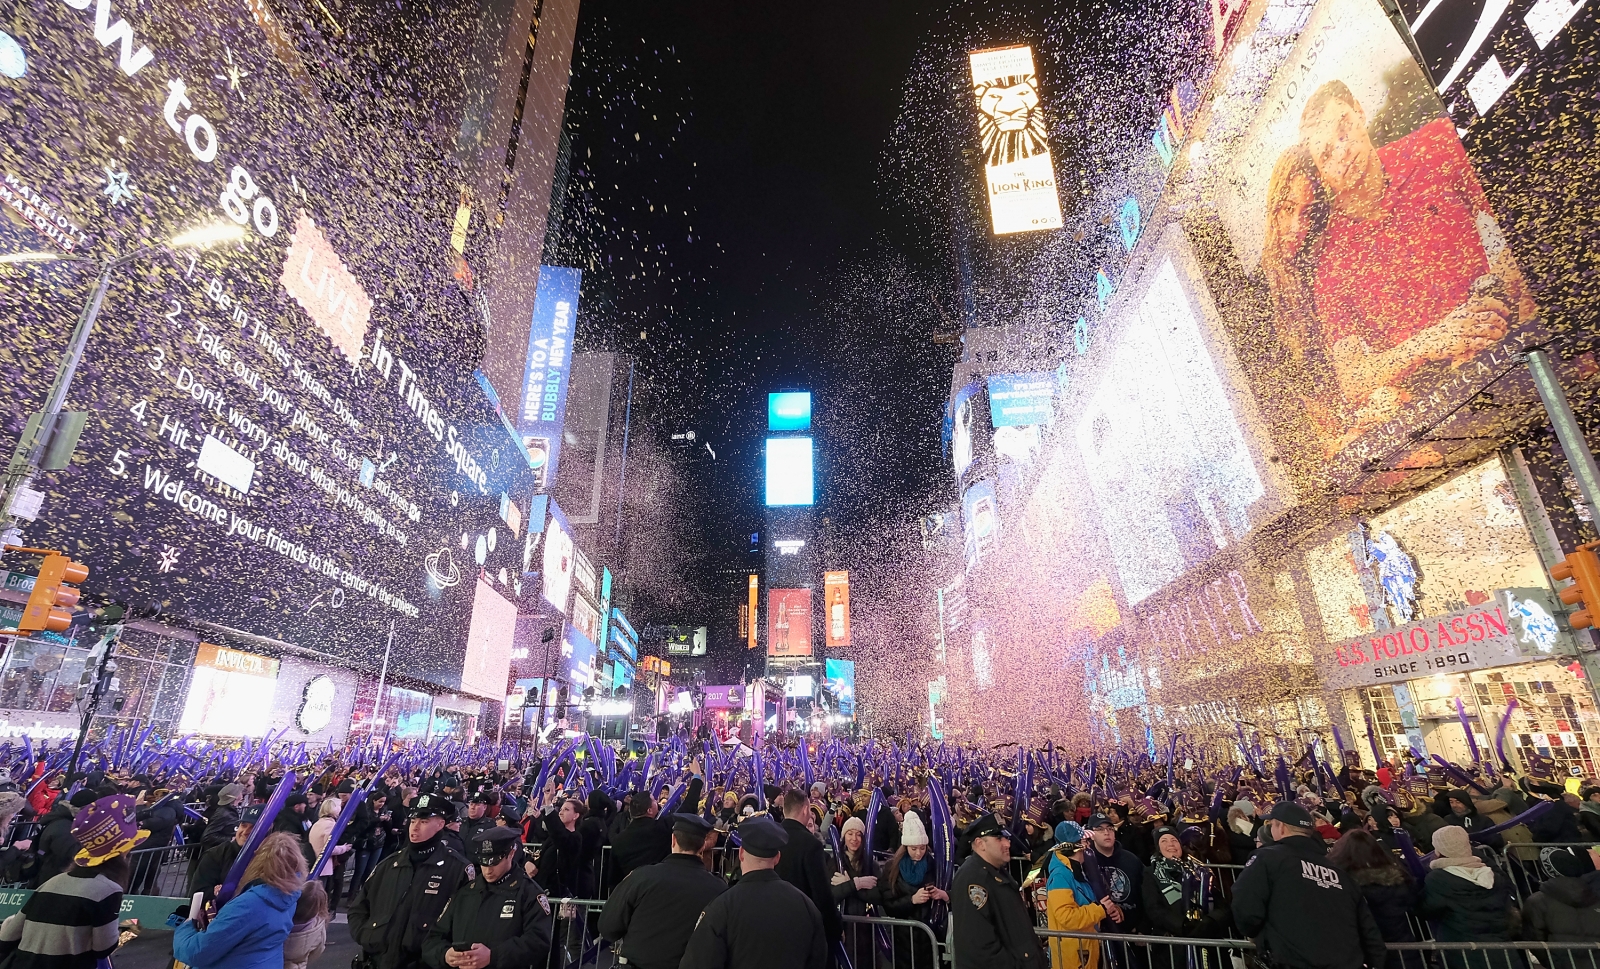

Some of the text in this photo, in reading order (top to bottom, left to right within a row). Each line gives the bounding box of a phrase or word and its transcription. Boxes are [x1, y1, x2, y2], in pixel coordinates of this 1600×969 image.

[164, 78, 217, 162] to
[220, 166, 278, 237] go
[991, 183, 1021, 195] LION
[1022, 178, 1053, 192] KING
[0, 173, 88, 250] MARRIOTT MARQUIS
[208, 278, 231, 310] Be
[233, 301, 248, 328] in
[252, 317, 291, 367] Times
[301, 247, 359, 336] LIVE
[165, 299, 182, 329] 2.
[195, 320, 231, 366] Take
[234, 361, 261, 391] out
[258, 382, 293, 415] your
[332, 440, 347, 461] Go
[347, 452, 359, 471] to
[371, 329, 392, 380] in
[399, 360, 444, 441] Times
[524, 338, 549, 422] HERE'S TO A
[541, 300, 571, 421] BUBBLY NEW YEAR
[129, 400, 191, 450] 4. Hit
[148, 346, 166, 377] 3.
[176, 366, 226, 417] Don't
[228, 407, 272, 452] worry
[272, 440, 310, 476] about
[310, 465, 336, 495] what
[363, 507, 386, 535] going
[108, 449, 129, 480] 5.
[143, 464, 228, 525] Welcome
[226, 510, 265, 542] your
[265, 527, 308, 564] friends
[308, 551, 321, 571] to
[322, 559, 340, 580] the
[340, 570, 368, 593] center
[9, 574, 35, 591] Broa
[215, 649, 264, 673] INVICTA
[668, 642, 690, 651] WICKED
[1369, 626, 1431, 662] POLO
[1437, 608, 1508, 649] ASSN
[1374, 652, 1470, 678] SINCE 1890
[707, 692, 723, 700] 2017
[83, 823, 122, 850] 2017
[1300, 859, 1340, 884] NYPD
